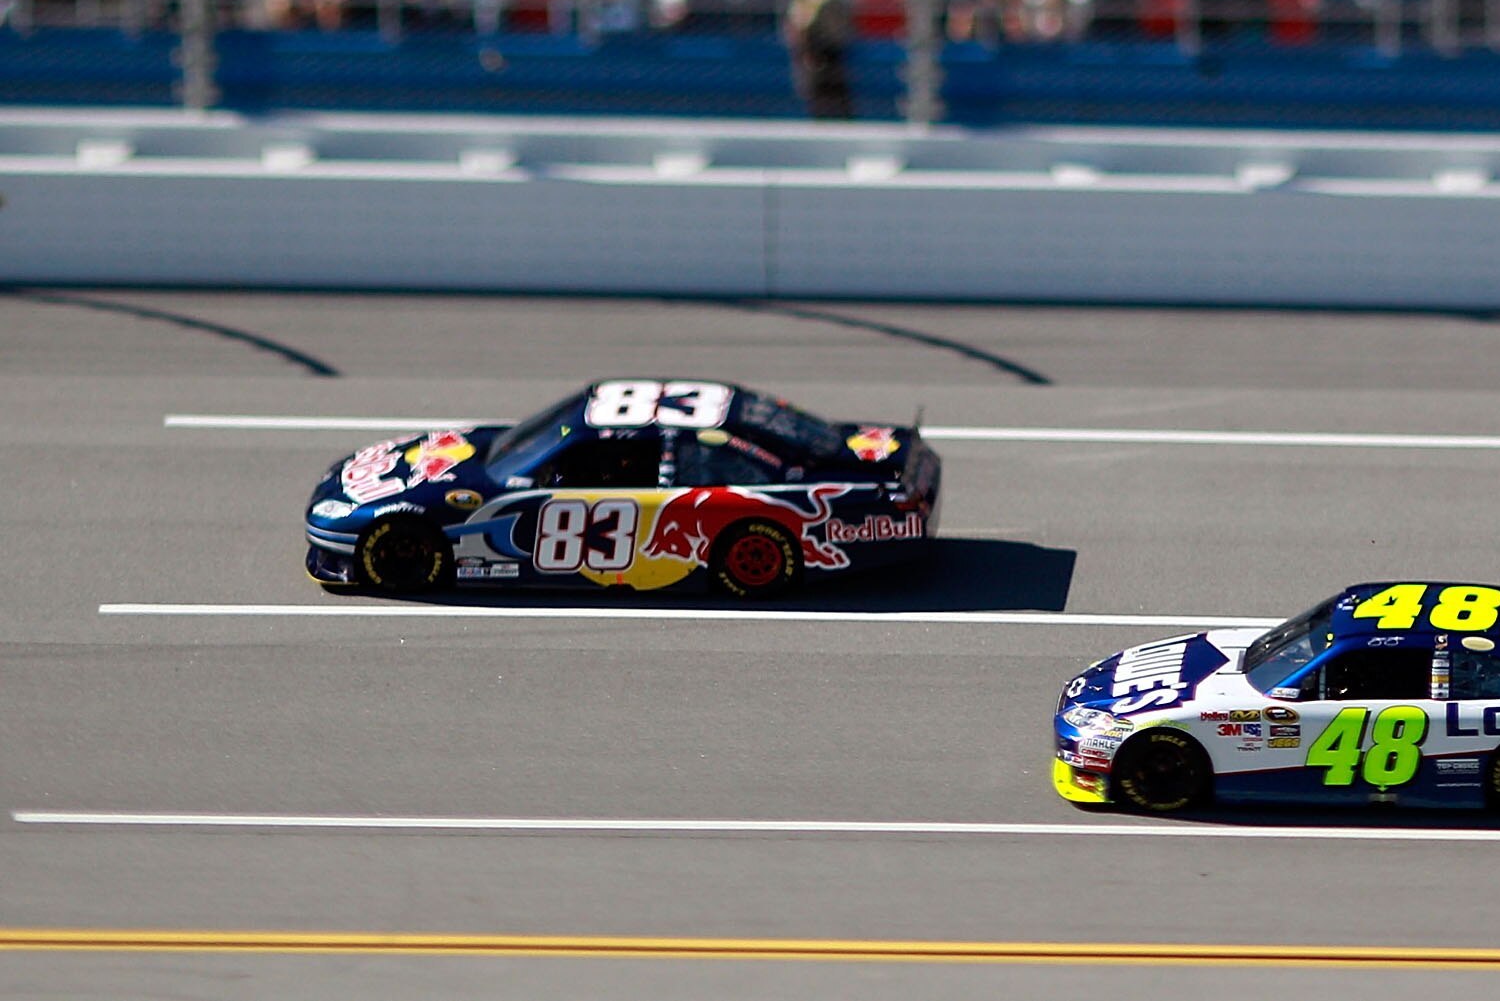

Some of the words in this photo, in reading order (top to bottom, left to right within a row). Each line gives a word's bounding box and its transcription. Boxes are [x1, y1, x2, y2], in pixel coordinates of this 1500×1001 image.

[584, 379, 735, 429] 83
[534, 499, 639, 575] 83
[826, 517, 874, 543] Red
[875, 511, 922, 541] Bull
[1111, 633, 1198, 714] LOWE'S
[1201, 712, 1229, 722] Holley
[1218, 724, 1242, 736] 3M
[1082, 738, 1116, 750] MAHLE
[1306, 706, 1430, 788] 48
